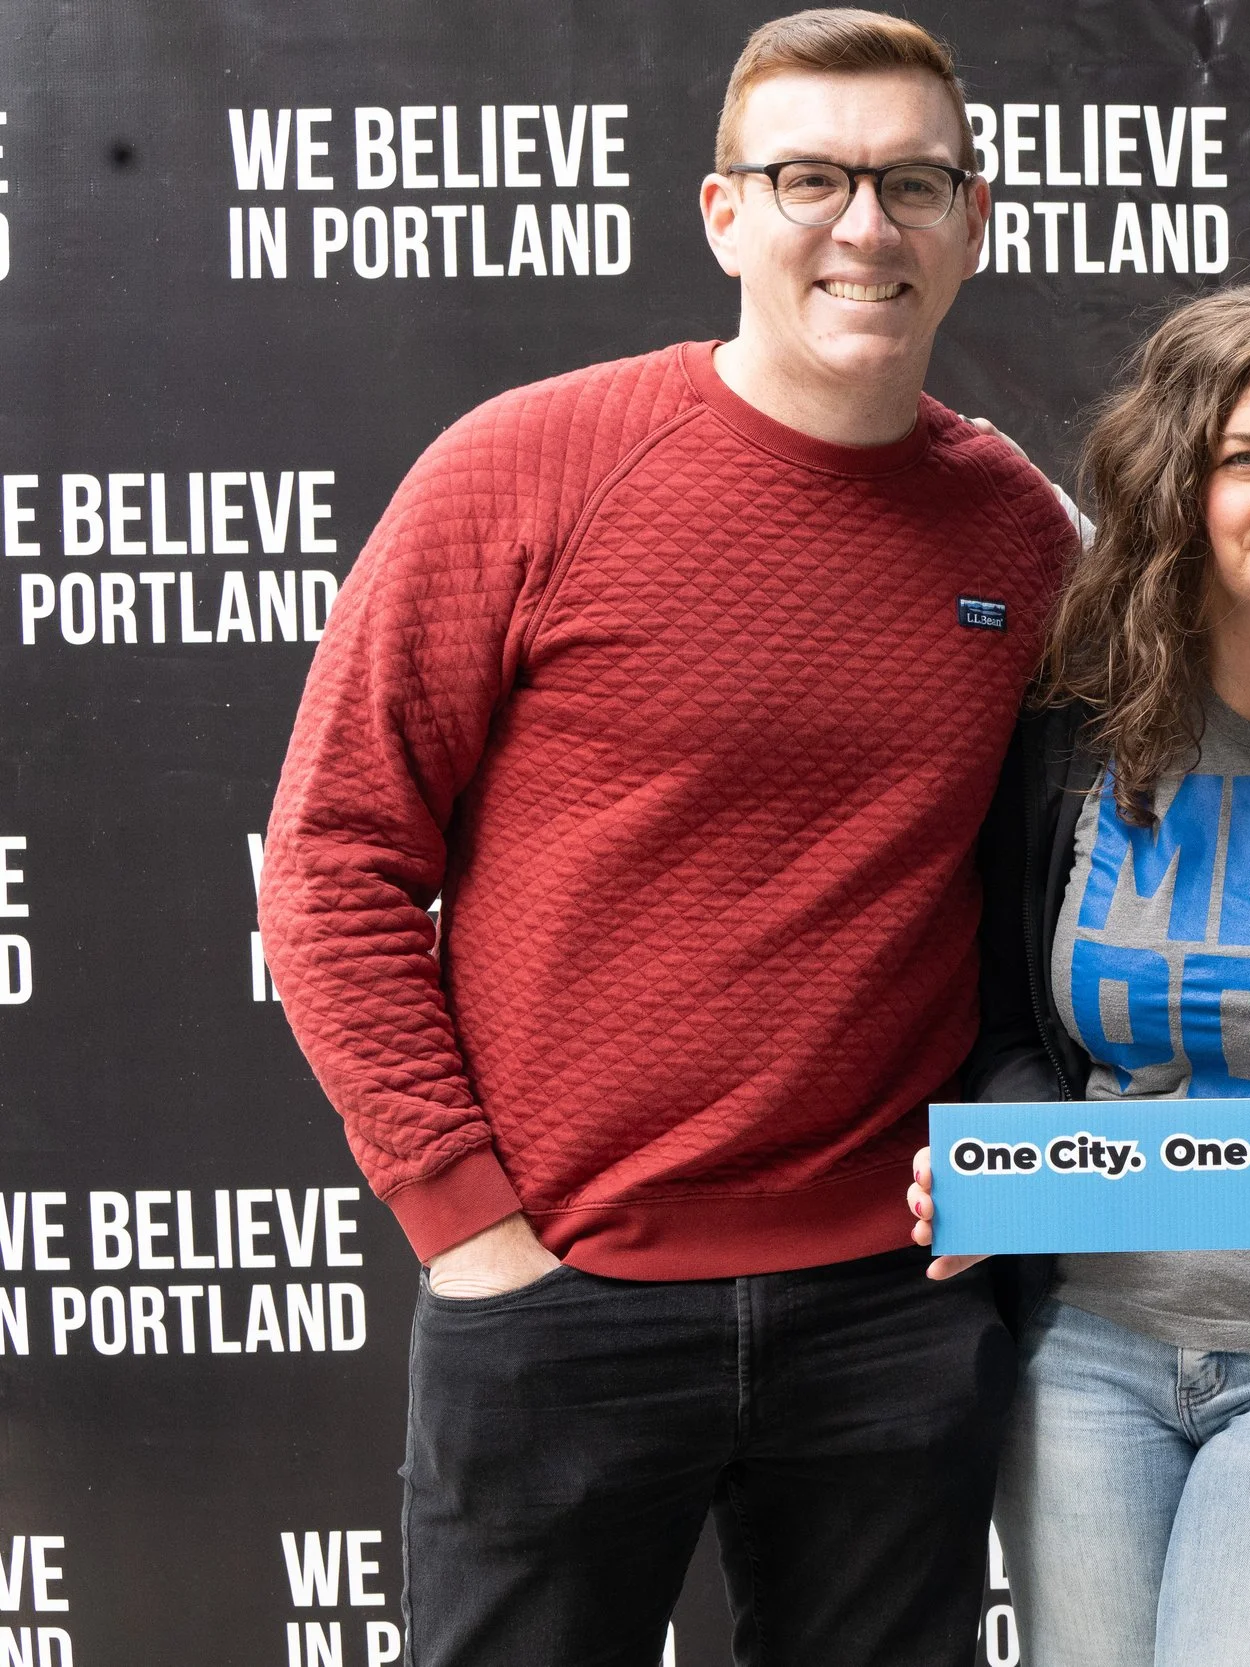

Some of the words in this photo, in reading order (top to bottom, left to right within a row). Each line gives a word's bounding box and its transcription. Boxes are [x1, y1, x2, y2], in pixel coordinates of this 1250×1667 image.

[229, 108, 334, 190] WE
[355, 104, 629, 190] BELIEVE
[966, 104, 1228, 187] BELIEVE
[229, 207, 287, 279] IN
[313, 204, 631, 279] PORTLAND
[976, 201, 1229, 274] RTLAND
[3, 474, 40, 556] E
[62, 471, 337, 556] BELIEVE
[21, 570, 338, 645] PORTLAND
[954, 1142, 1036, 1171] One
[1049, 1137, 1140, 1175] City.
[1165, 1138, 1247, 1167] One
[90, 1188, 363, 1270] BELIEVE
[0, 1286, 30, 1355] N
[51, 1283, 366, 1356] PORTLAND
[281, 1530, 385, 1606] WE
[286, 1621, 343, 1667] IN
